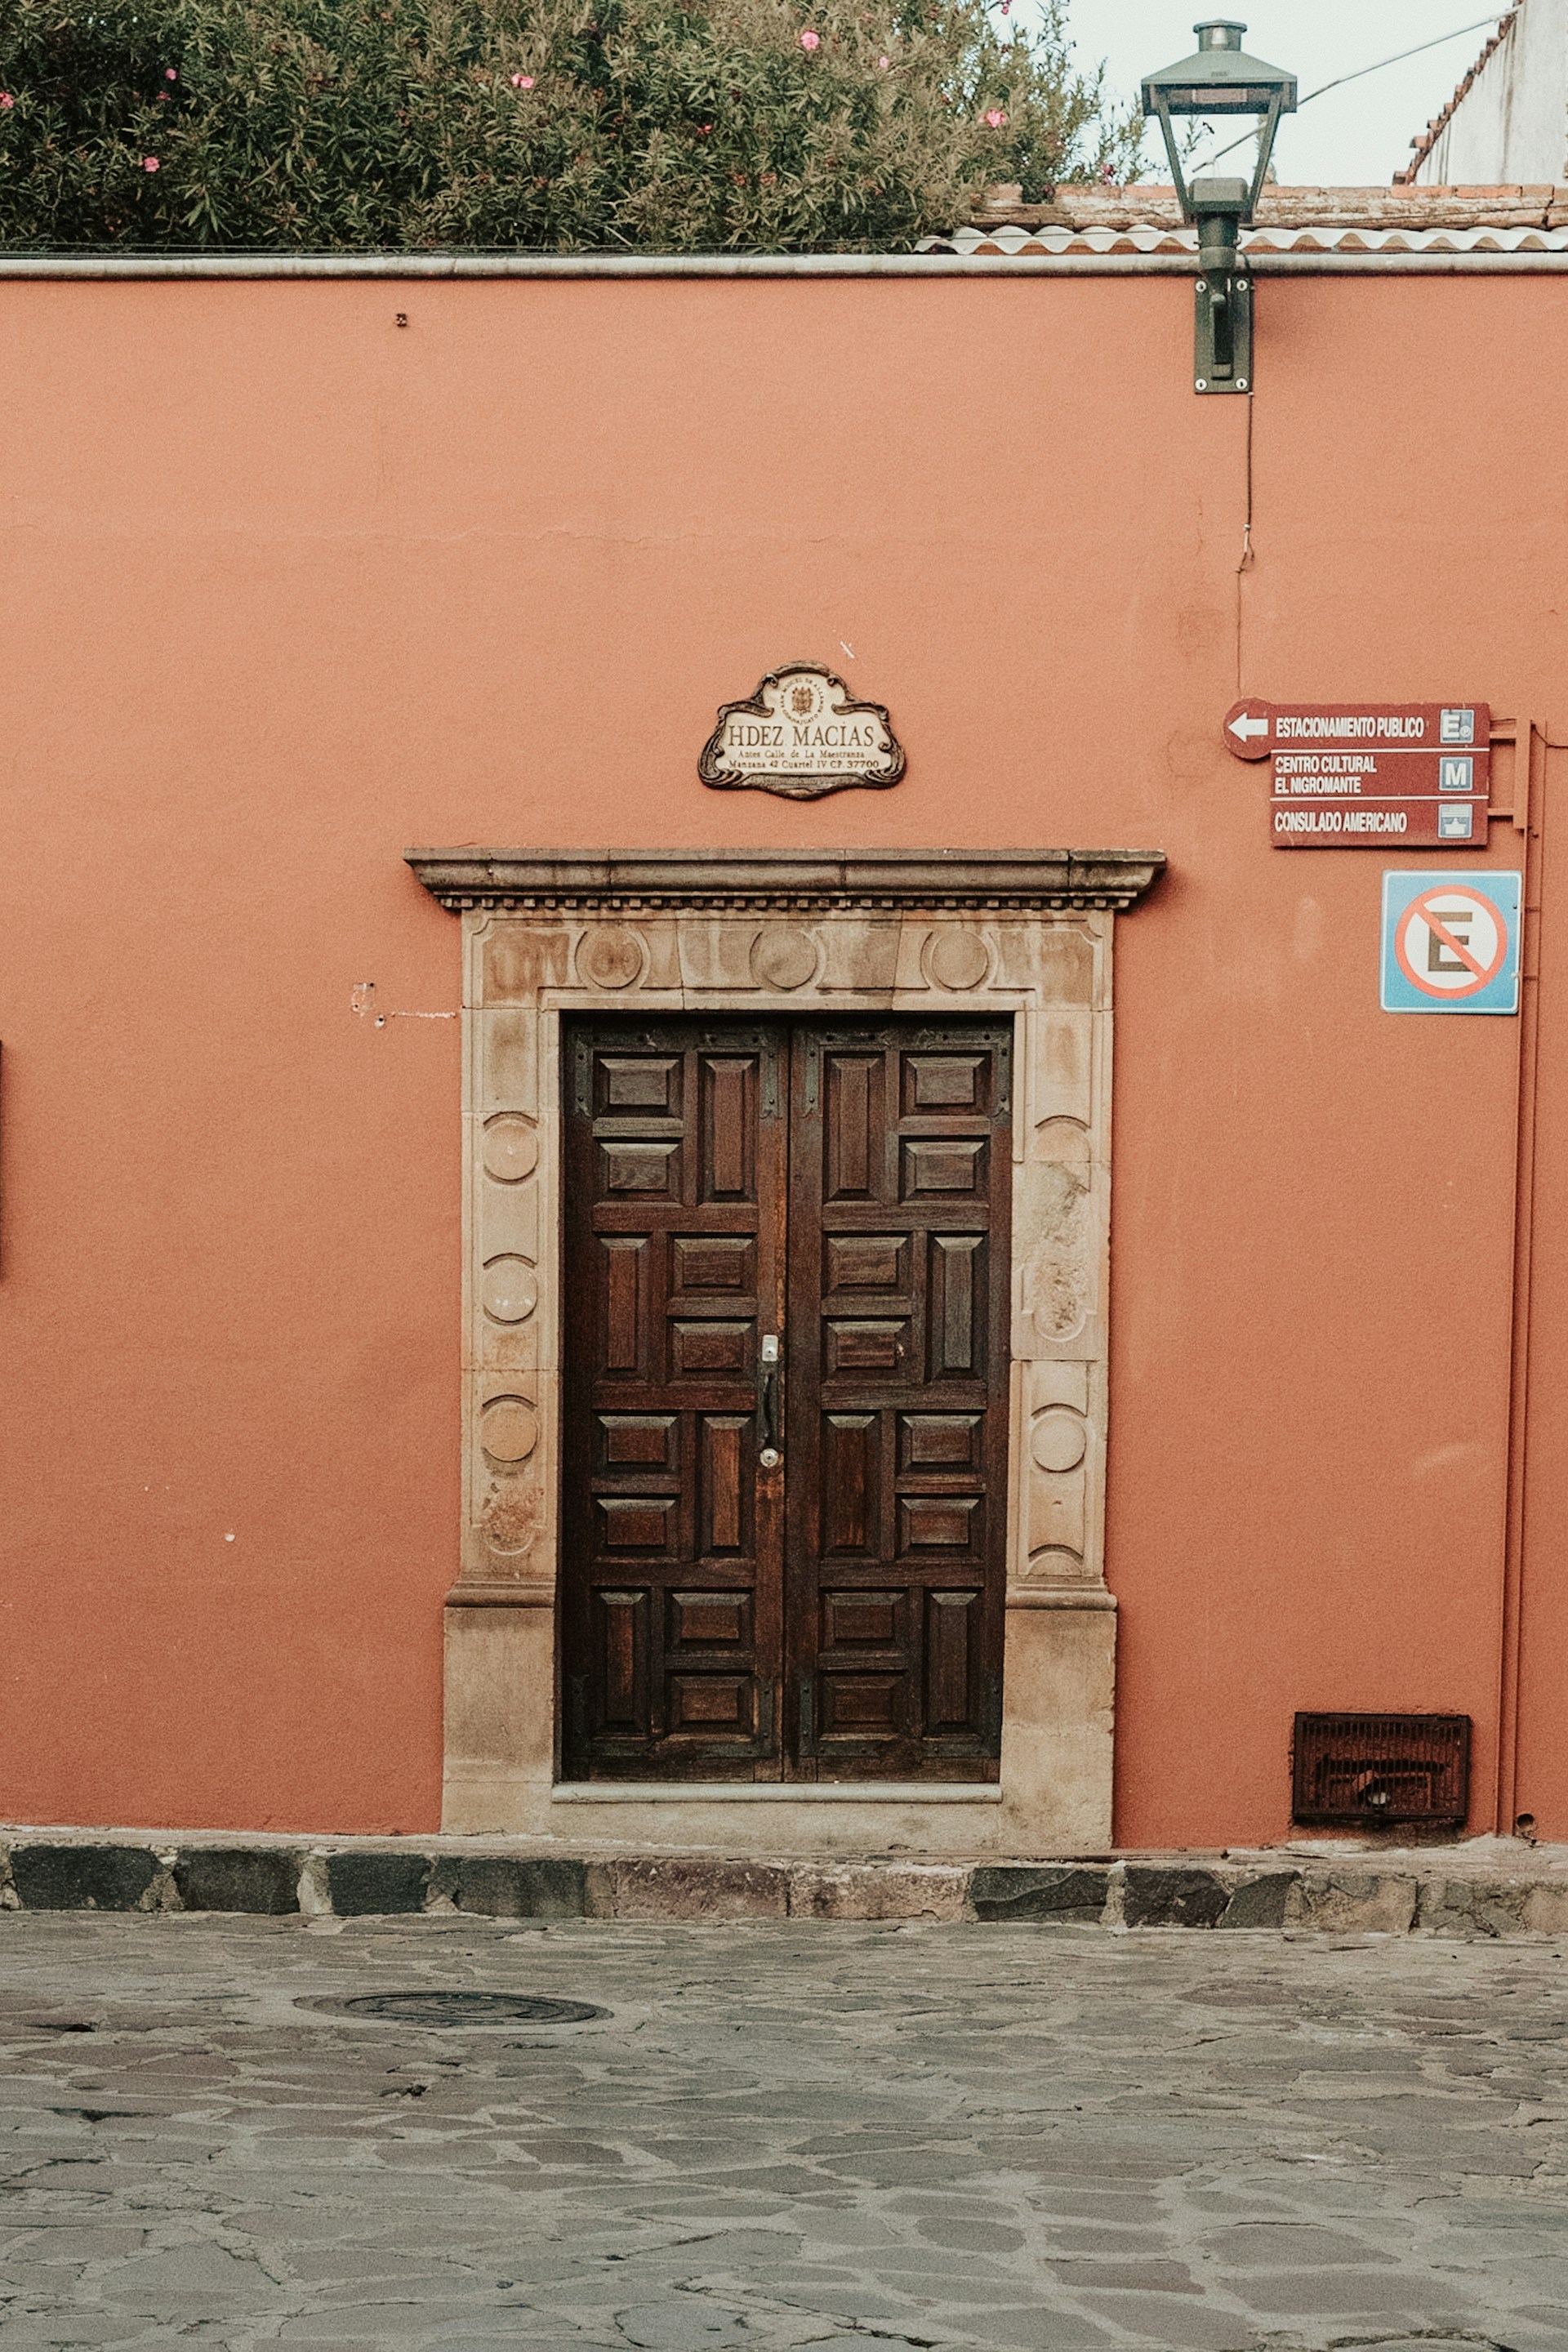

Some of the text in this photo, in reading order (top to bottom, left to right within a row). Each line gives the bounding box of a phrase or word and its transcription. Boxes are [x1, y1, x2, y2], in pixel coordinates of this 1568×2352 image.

[728, 725, 784, 746] HDEZ
[1276, 716, 1376, 737] ESTACIONAMIENTO
[1377, 716, 1424, 737] PUBLICO
[738, 749, 864, 758] Antes Calle de La Maestranza
[728, 760, 765, 768] Manzana
[782, 760, 813, 768] Cuartel
[817, 760, 827, 768] IV
[846, 760, 880, 768] 37700
[1275, 755, 1377, 773] CENTRO CULTURAL
[1445, 763, 1467, 786] M
[1275, 777, 1361, 794] EL NIGROMANTE
[1275, 811, 1407, 832] CONSULADO AMERICANO
